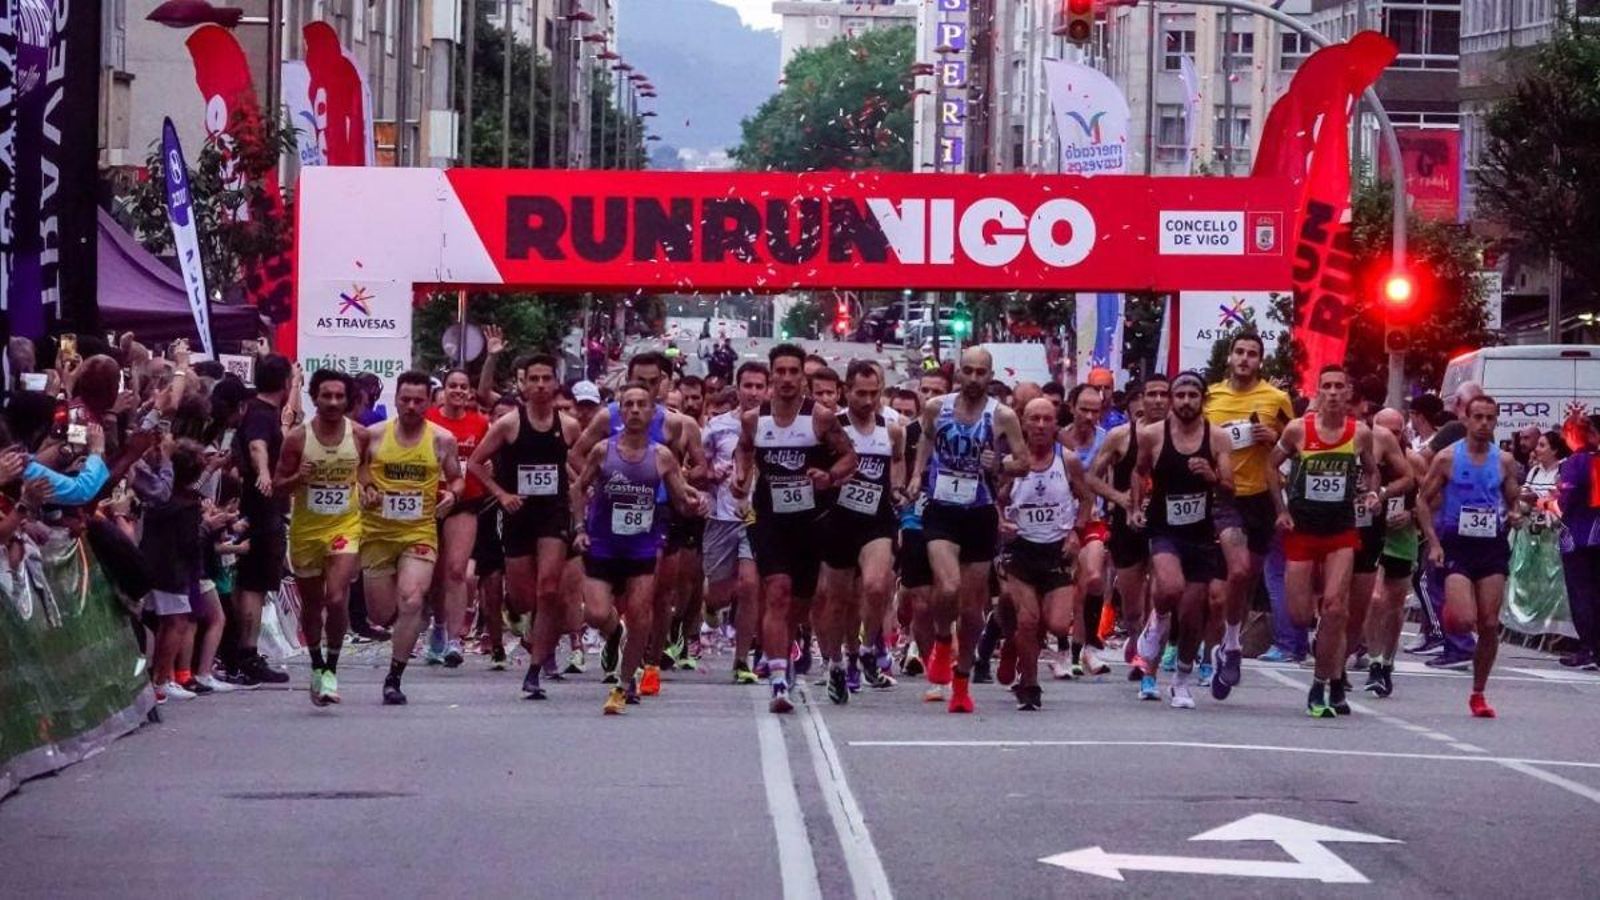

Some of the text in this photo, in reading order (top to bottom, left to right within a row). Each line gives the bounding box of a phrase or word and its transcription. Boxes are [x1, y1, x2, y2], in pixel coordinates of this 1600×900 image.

[1165, 220, 1237, 232] CONCELLO
[1174, 234, 1229, 245] DE VIGO
[317, 317, 395, 329] AS TRAVESAS
[1197, 329, 1211, 339] AS
[363, 359, 403, 377] auga
[525, 472, 552, 486] 155
[1312, 478, 1340, 492] 295
[952, 480, 960, 493] 1
[314, 491, 344, 505] 252
[783, 489, 802, 503] 36
[846, 486, 875, 504] 228
[390, 497, 416, 511] 153
[1173, 501, 1201, 516] 307
[624, 511, 642, 525] 68
[1027, 508, 1055, 523] 102
[1470, 514, 1488, 528] 34
